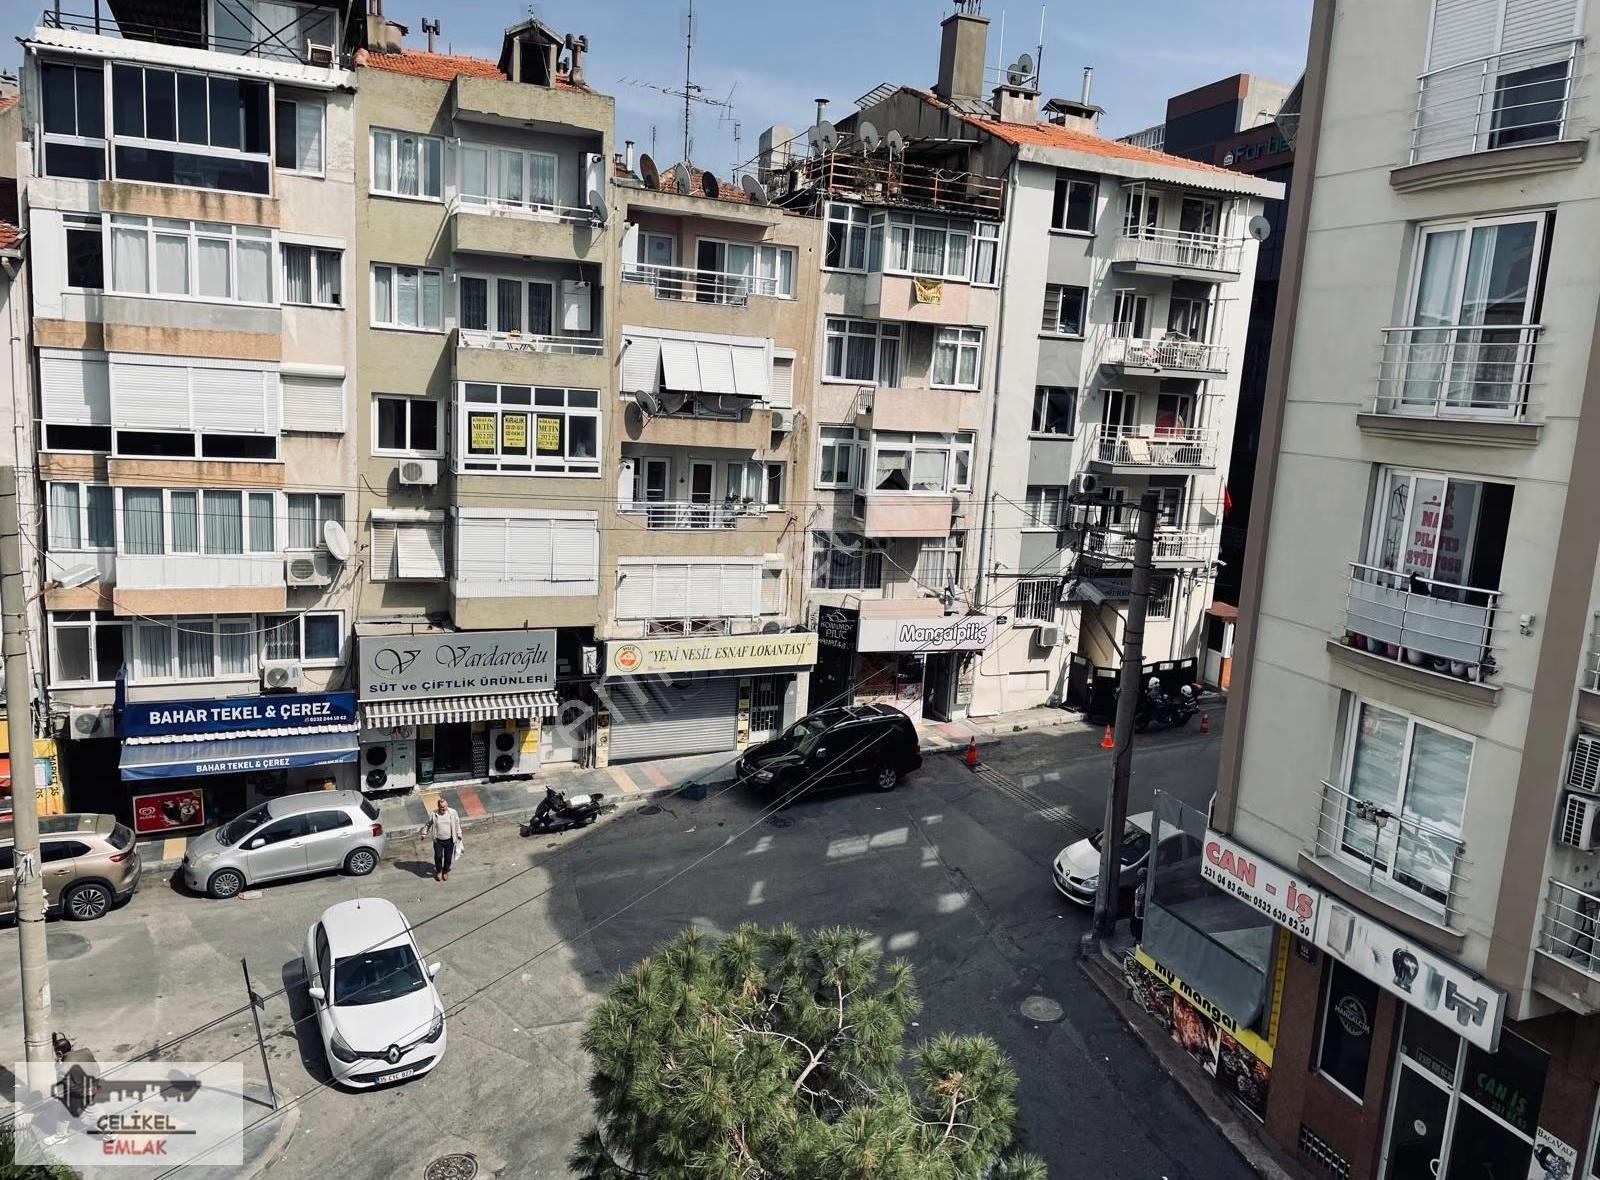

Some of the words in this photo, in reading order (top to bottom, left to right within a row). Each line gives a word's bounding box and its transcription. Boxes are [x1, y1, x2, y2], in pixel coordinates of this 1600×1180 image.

[900, 623, 987, 647] Mangalpiliç
[435, 643, 548, 673] Vardaroğlu
[681, 644, 712, 660] NESİL
[715, 645, 749, 659] ESNAF
[369, 682, 397, 693] SÜT
[402, 683, 417, 691] ve
[422, 677, 476, 692] ÇİFTLİK
[480, 673, 548, 686] ÜRÜNLERİ
[150, 708, 208, 726] BAHAR
[211, 706, 262, 722] TEKEL
[265, 705, 277, 718] &
[280, 702, 331, 720] ÇEREZ
[196, 763, 226, 773] BAHAR
[227, 761, 254, 771] TEKEL
[255, 760, 262, 769] &
[263, 758, 290, 769] ÇEREZ
[1205, 841, 1257, 888] CAN
[1204, 866, 1216, 880] 231
[1216, 872, 1226, 886] 04
[1253, 896, 1271, 914] 0532
[1273, 908, 1287, 923] 630
[1288, 916, 1298, 929] 82
[1299, 924, 1310, 936] 30
[1154, 960, 1176, 984] my
[1179, 982, 1237, 1033] mangal
